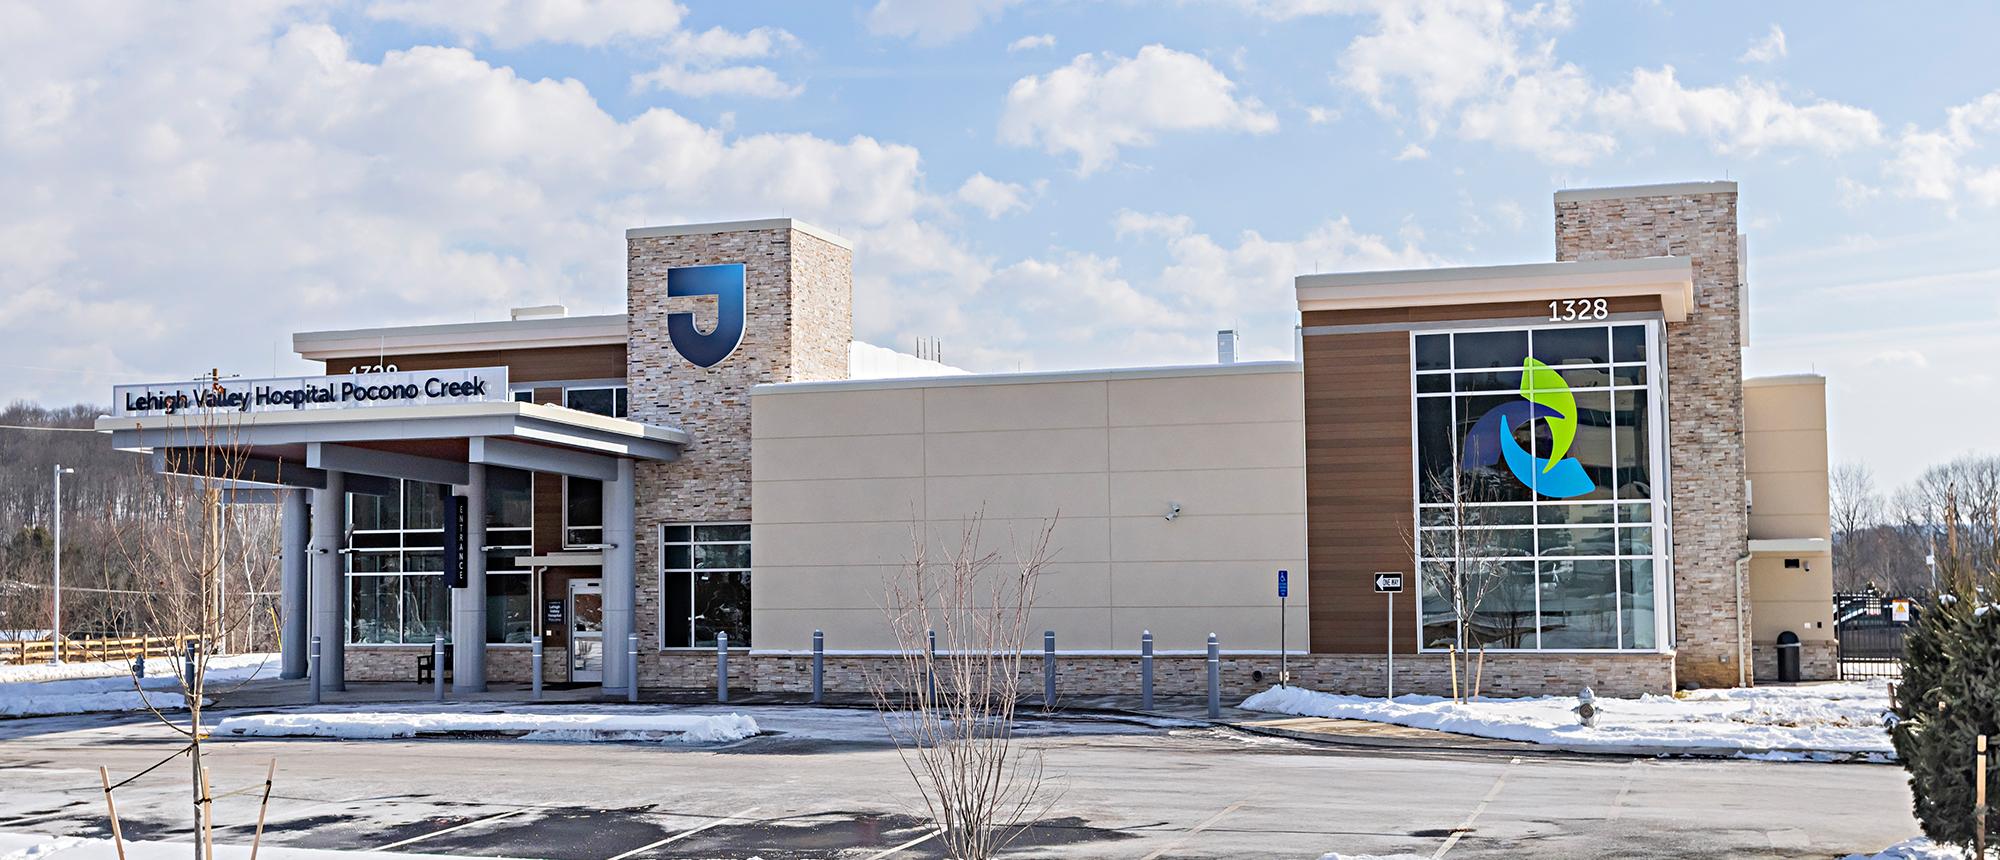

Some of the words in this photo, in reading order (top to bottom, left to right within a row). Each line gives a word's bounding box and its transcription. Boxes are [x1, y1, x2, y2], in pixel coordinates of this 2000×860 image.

[1549, 298, 1608, 321] 1328
[126, 390, 188, 414] Lehigh
[193, 388, 250, 411] Valley
[256, 383, 335, 409] Hospital
[342, 382, 419, 401] Pocono
[425, 376, 485, 398] Creek
[1383, 578, 1391, 586] ONE
